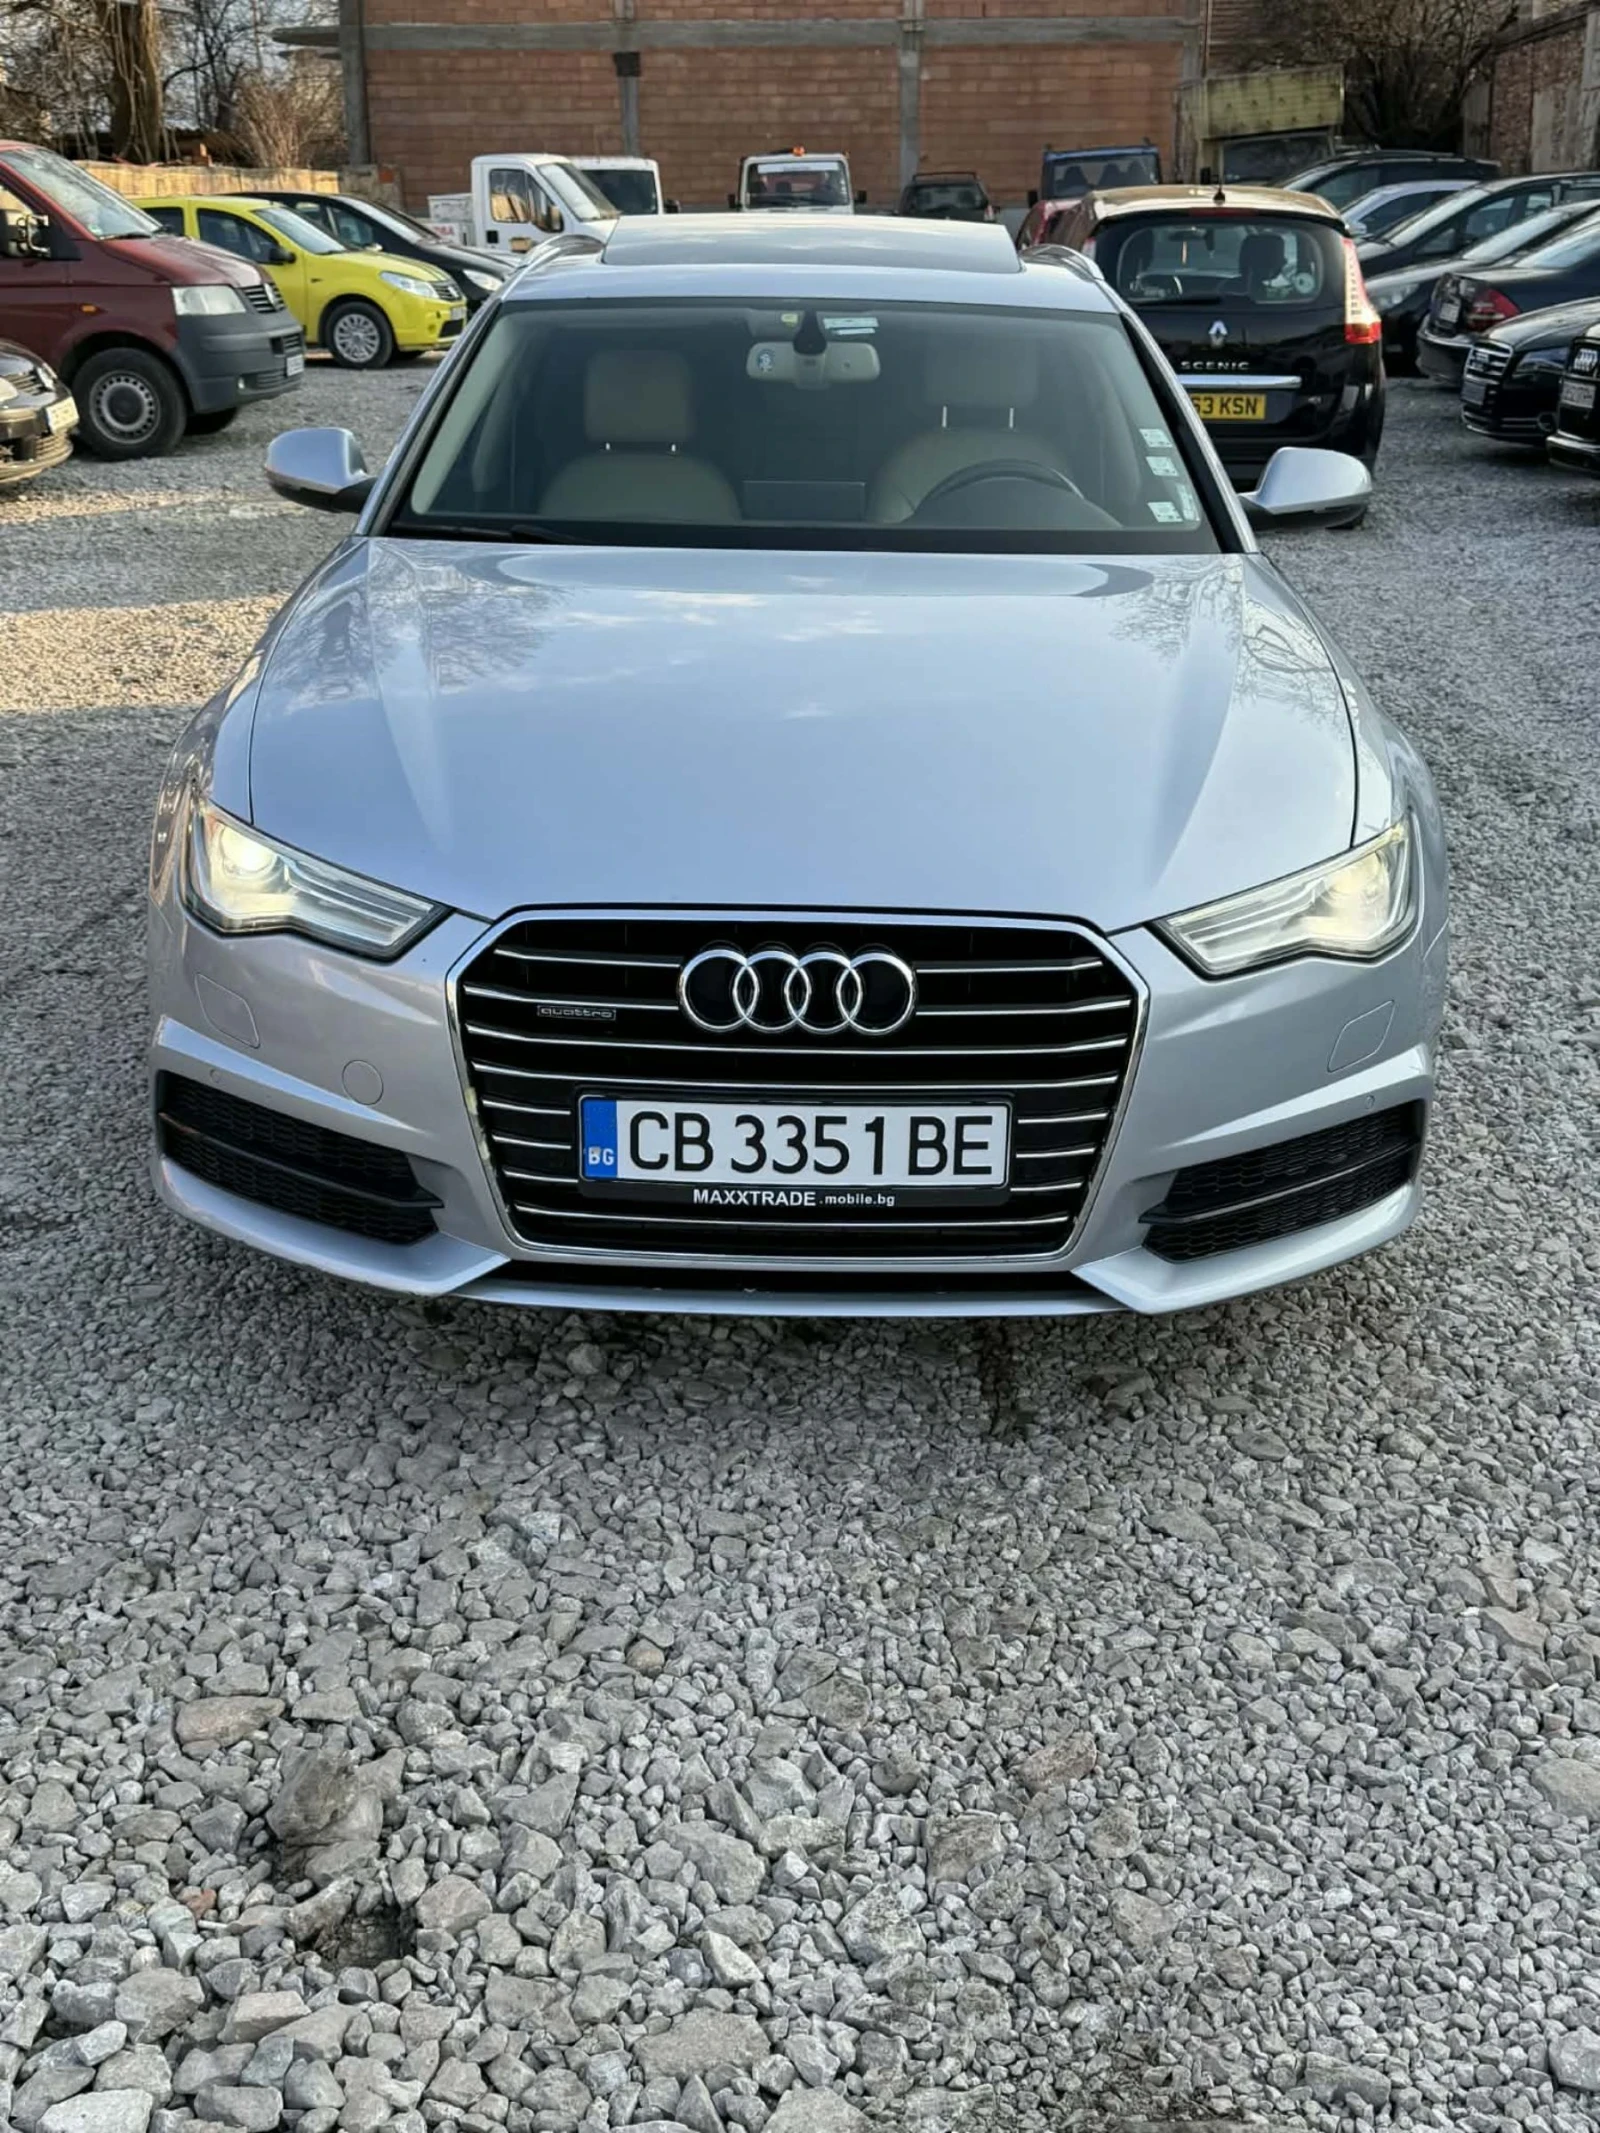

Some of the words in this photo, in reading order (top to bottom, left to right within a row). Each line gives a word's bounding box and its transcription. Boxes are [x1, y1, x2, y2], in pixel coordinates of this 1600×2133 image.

[1180, 361, 1250, 370] SCENIC
[1219, 396, 1258, 415] KSN
[540, 1007, 613, 1018] quattro
[629, 1111, 714, 1172] CB
[730, 1114, 885, 1176] 3351
[907, 1115, 993, 1176] BE
[588, 1147, 615, 1166] BG
[693, 1188, 816, 1207] MAXXTRADE
[818, 1192, 895, 1207] .mobile.bg
